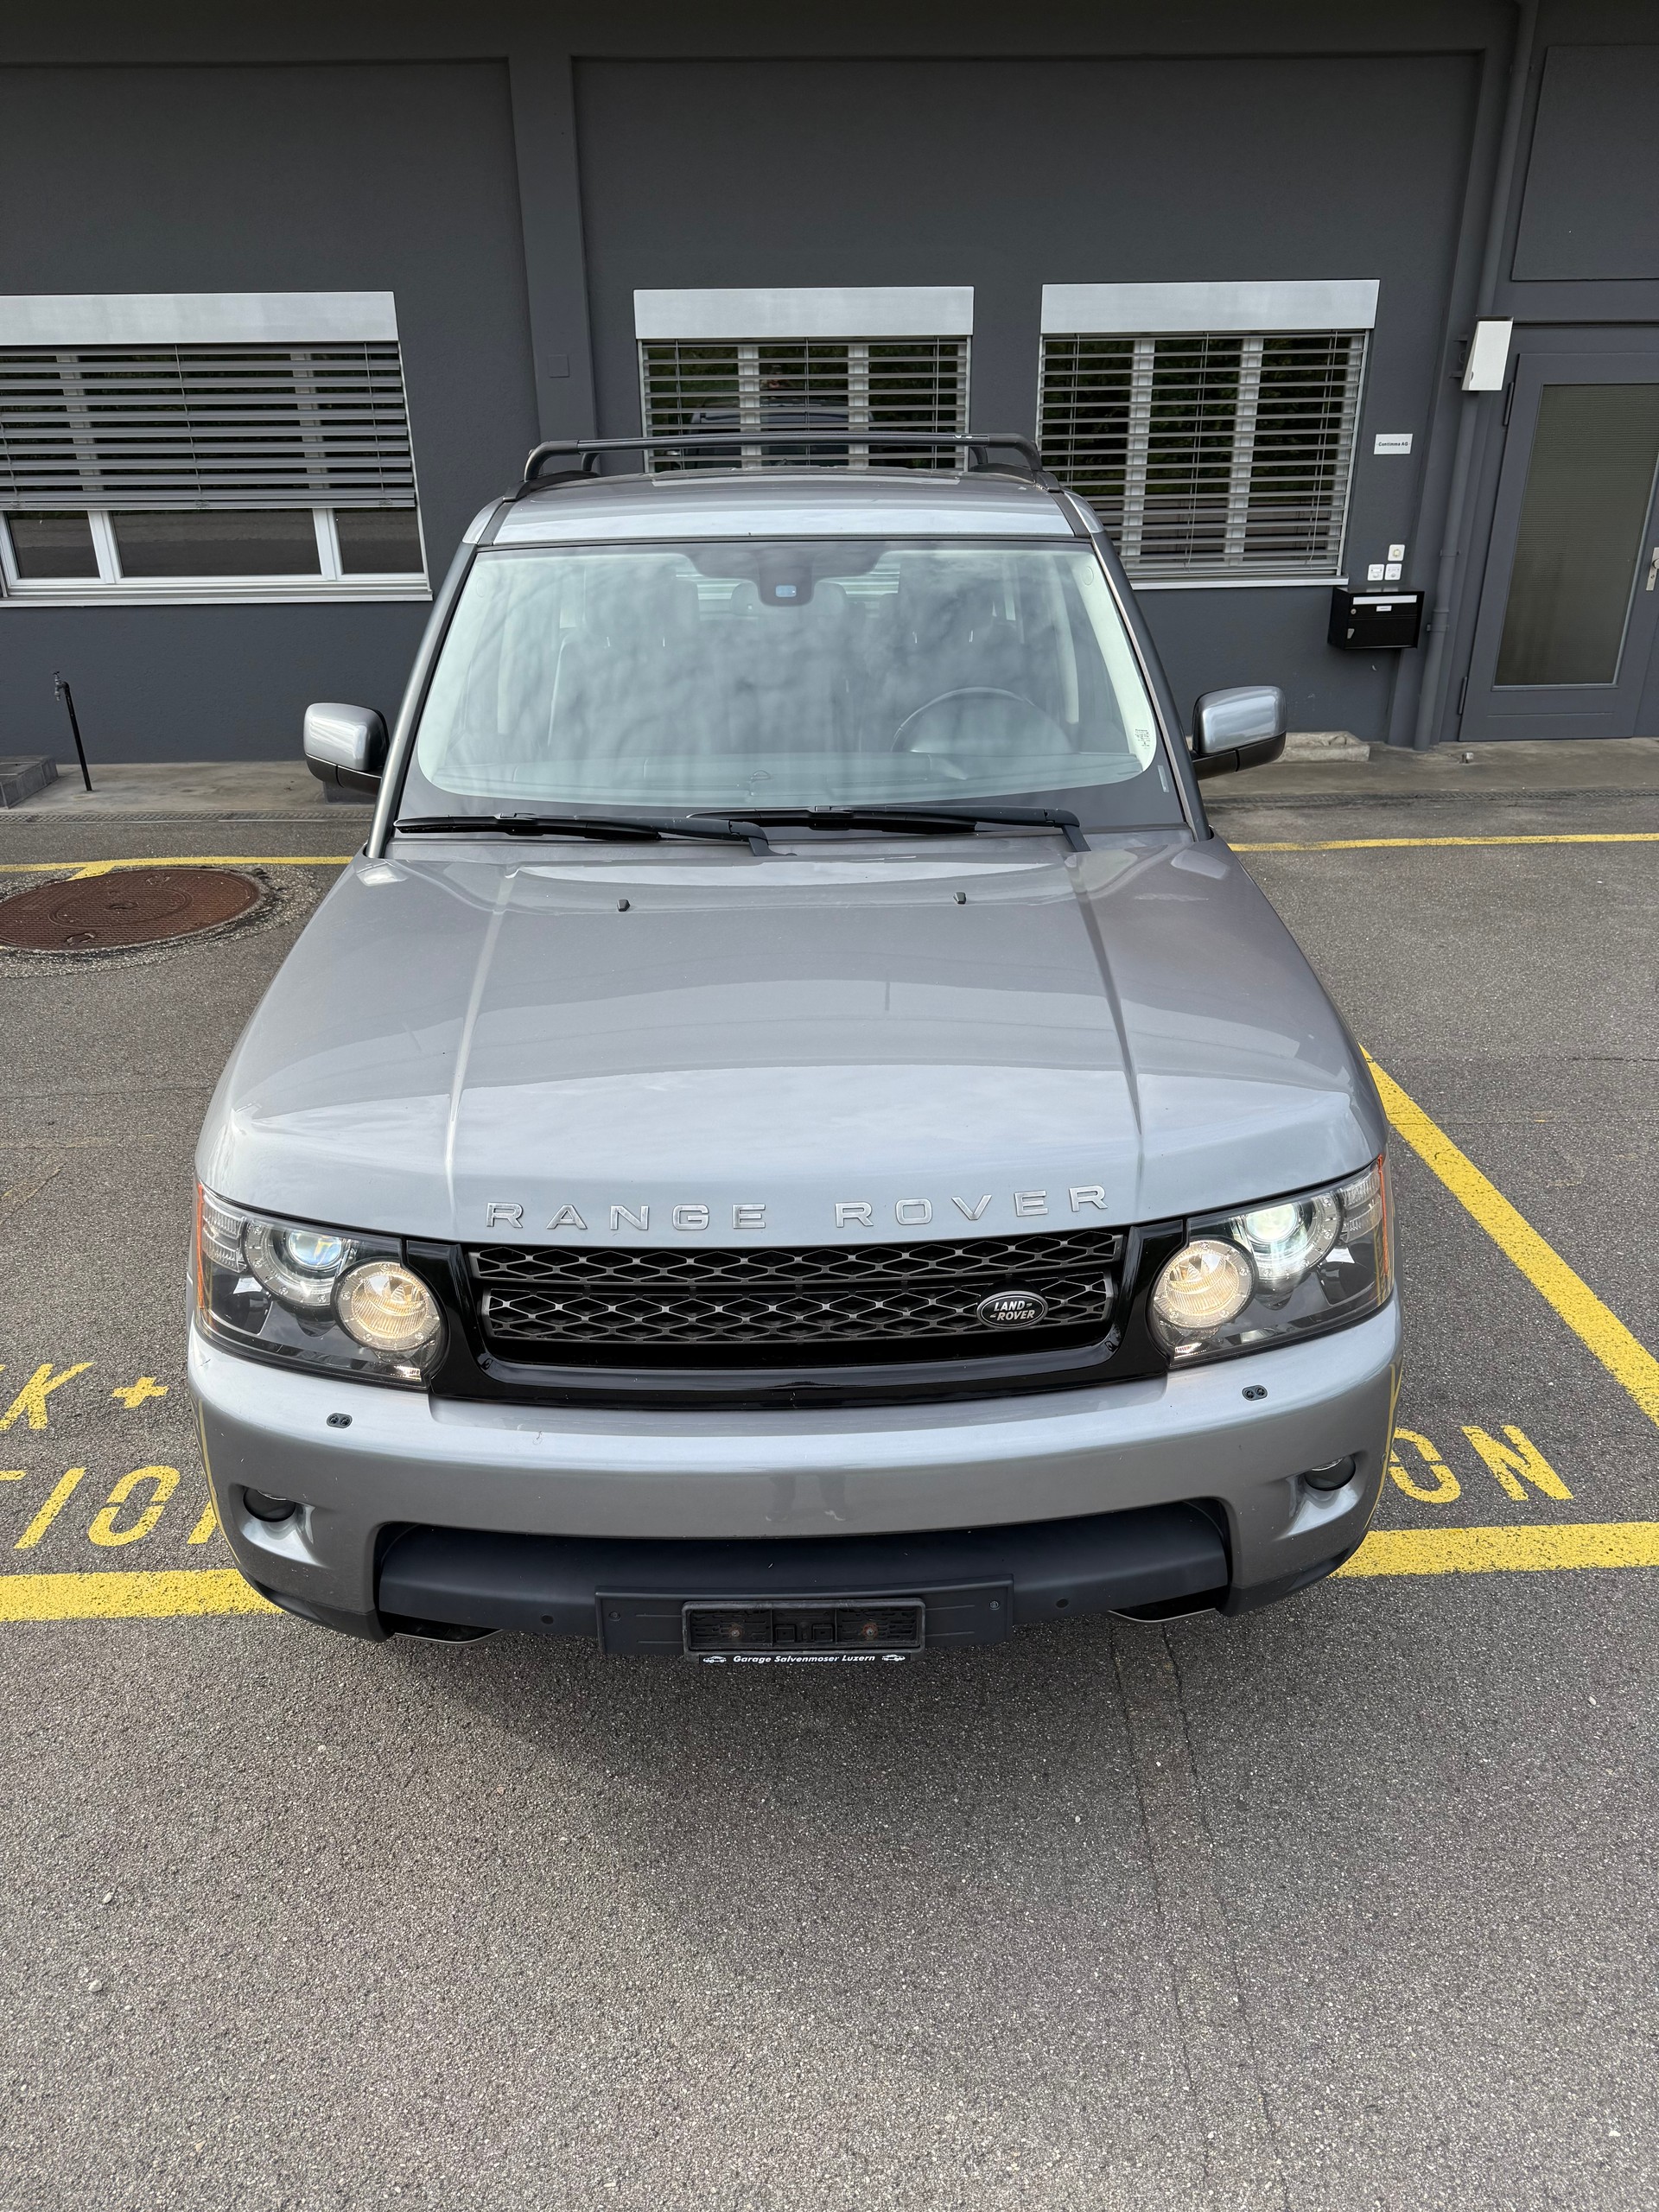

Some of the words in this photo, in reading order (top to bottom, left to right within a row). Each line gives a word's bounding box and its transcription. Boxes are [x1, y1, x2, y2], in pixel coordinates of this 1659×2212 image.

[486, 1201, 767, 1231] RANGE
[835, 1184, 1109, 1229] ROVER
[994, 1300, 1026, 1312] LAND
[996, 1309, 1036, 1321] ROVER
[733, 1655, 772, 1664] Garage
